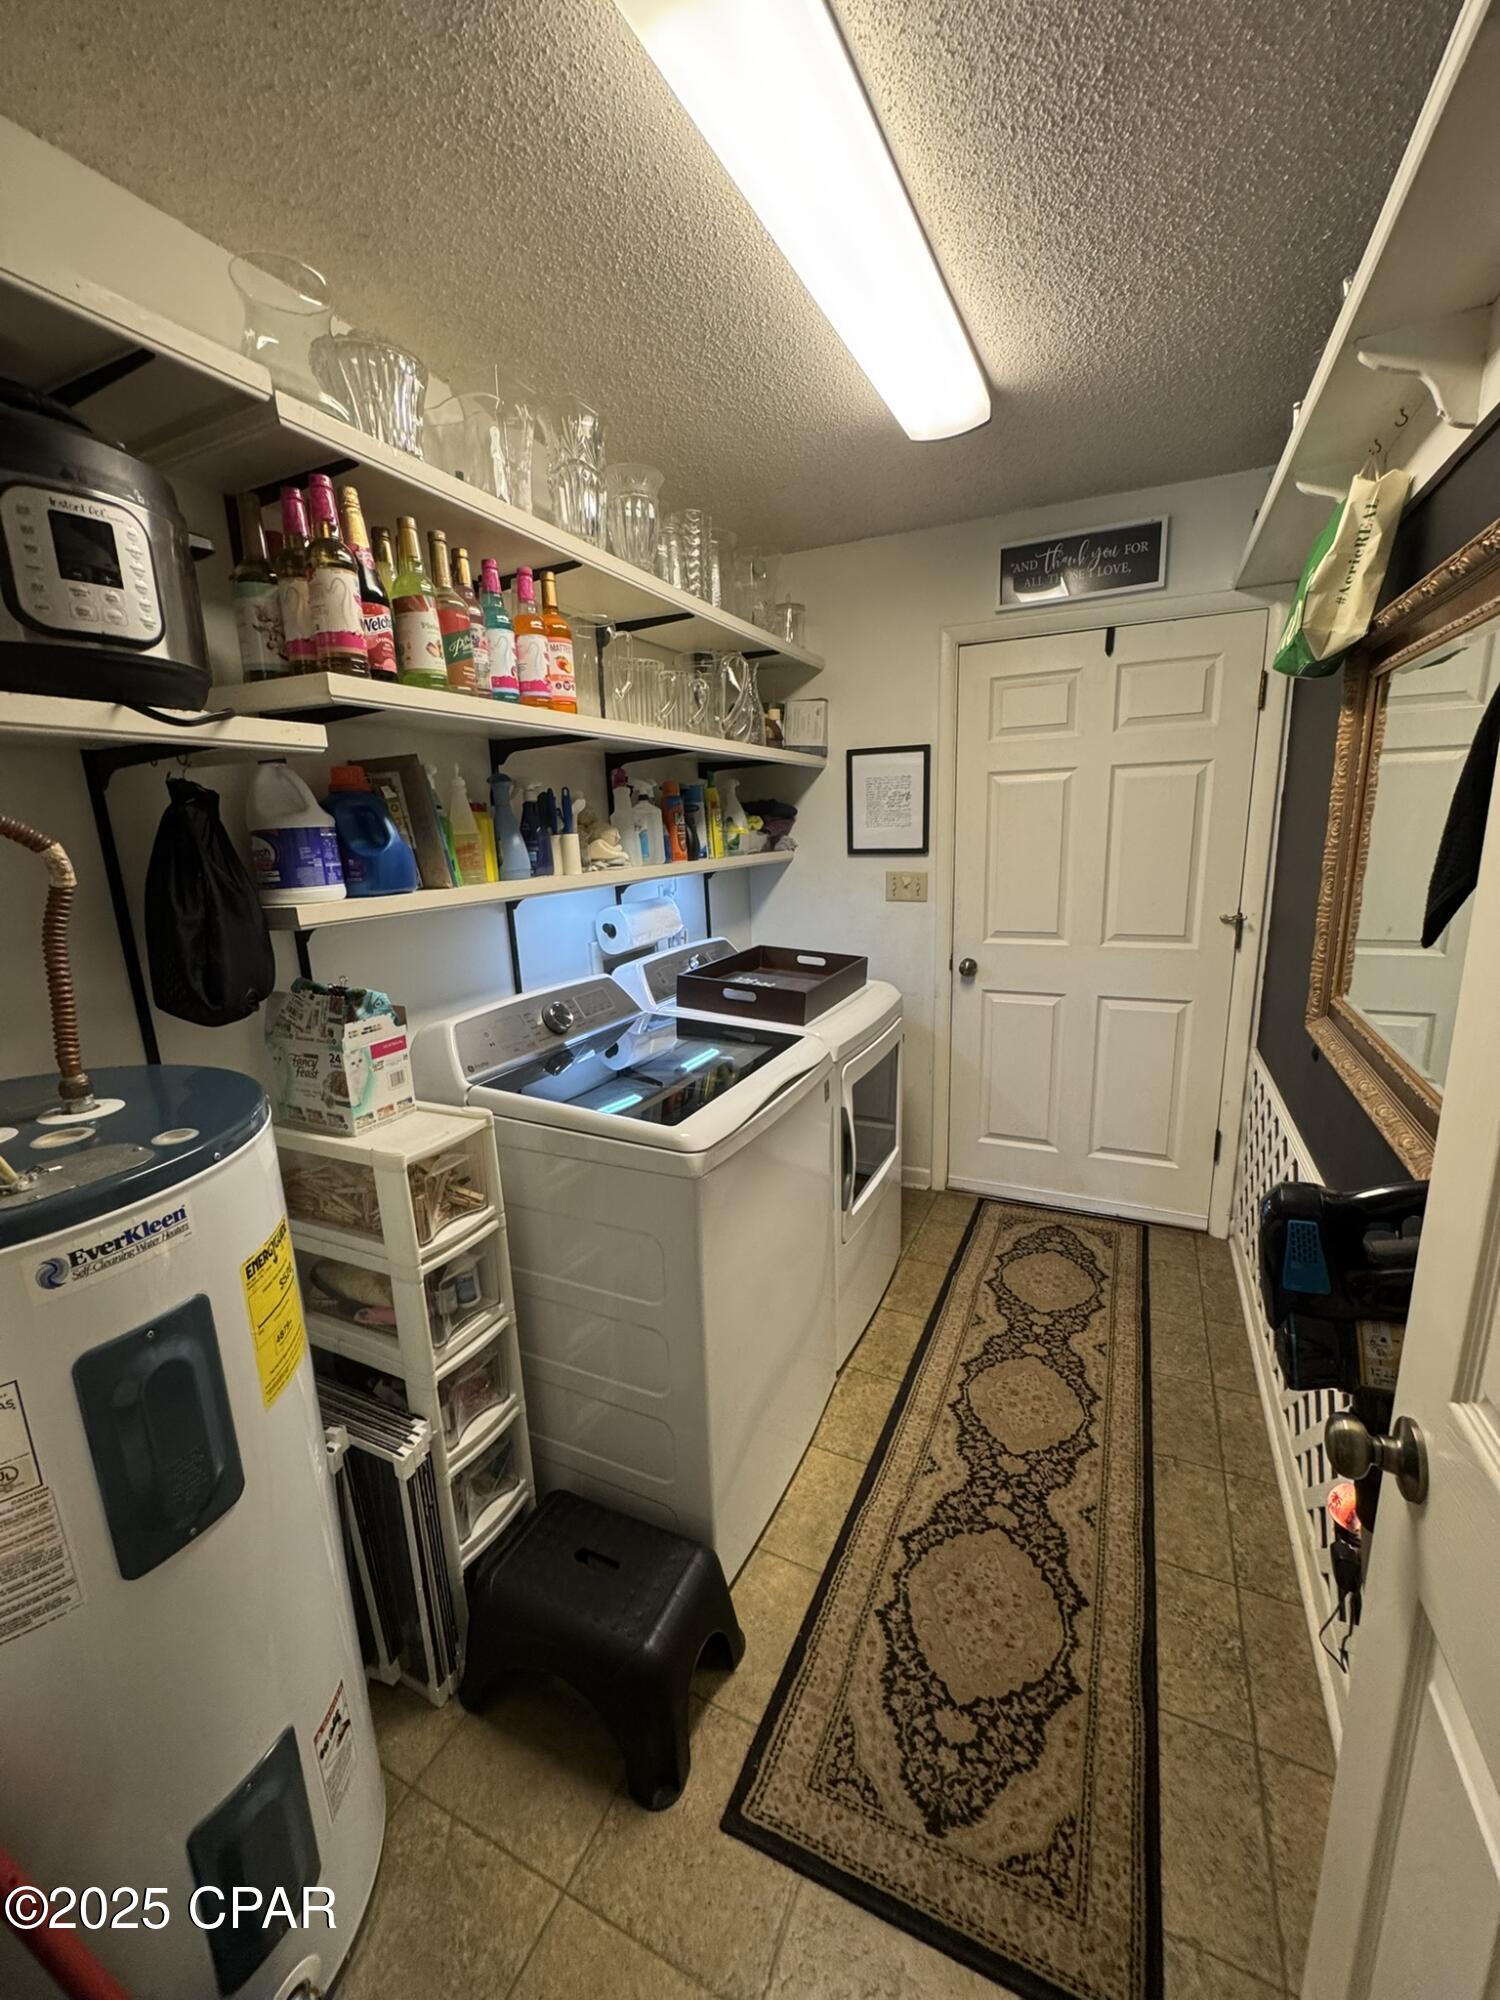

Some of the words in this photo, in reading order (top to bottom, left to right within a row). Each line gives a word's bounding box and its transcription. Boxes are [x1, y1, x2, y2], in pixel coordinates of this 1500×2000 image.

[1035, 538, 1089, 574] thank
[1089, 545, 1119, 573] you
[1124, 541, 1149, 556] FOR
[1024, 575, 1042, 588] ALL
[288, 1052, 319, 1071] Fancy
[329, 1053, 342, 1065] 24
[295, 1066, 320, 1080] Feast
[66, 1207, 187, 1269] EverKleen
[71, 1249, 136, 1281] Self-Cleaning
[136, 1237, 161, 1255] Water
[161, 1222, 190, 1242] Heaters
